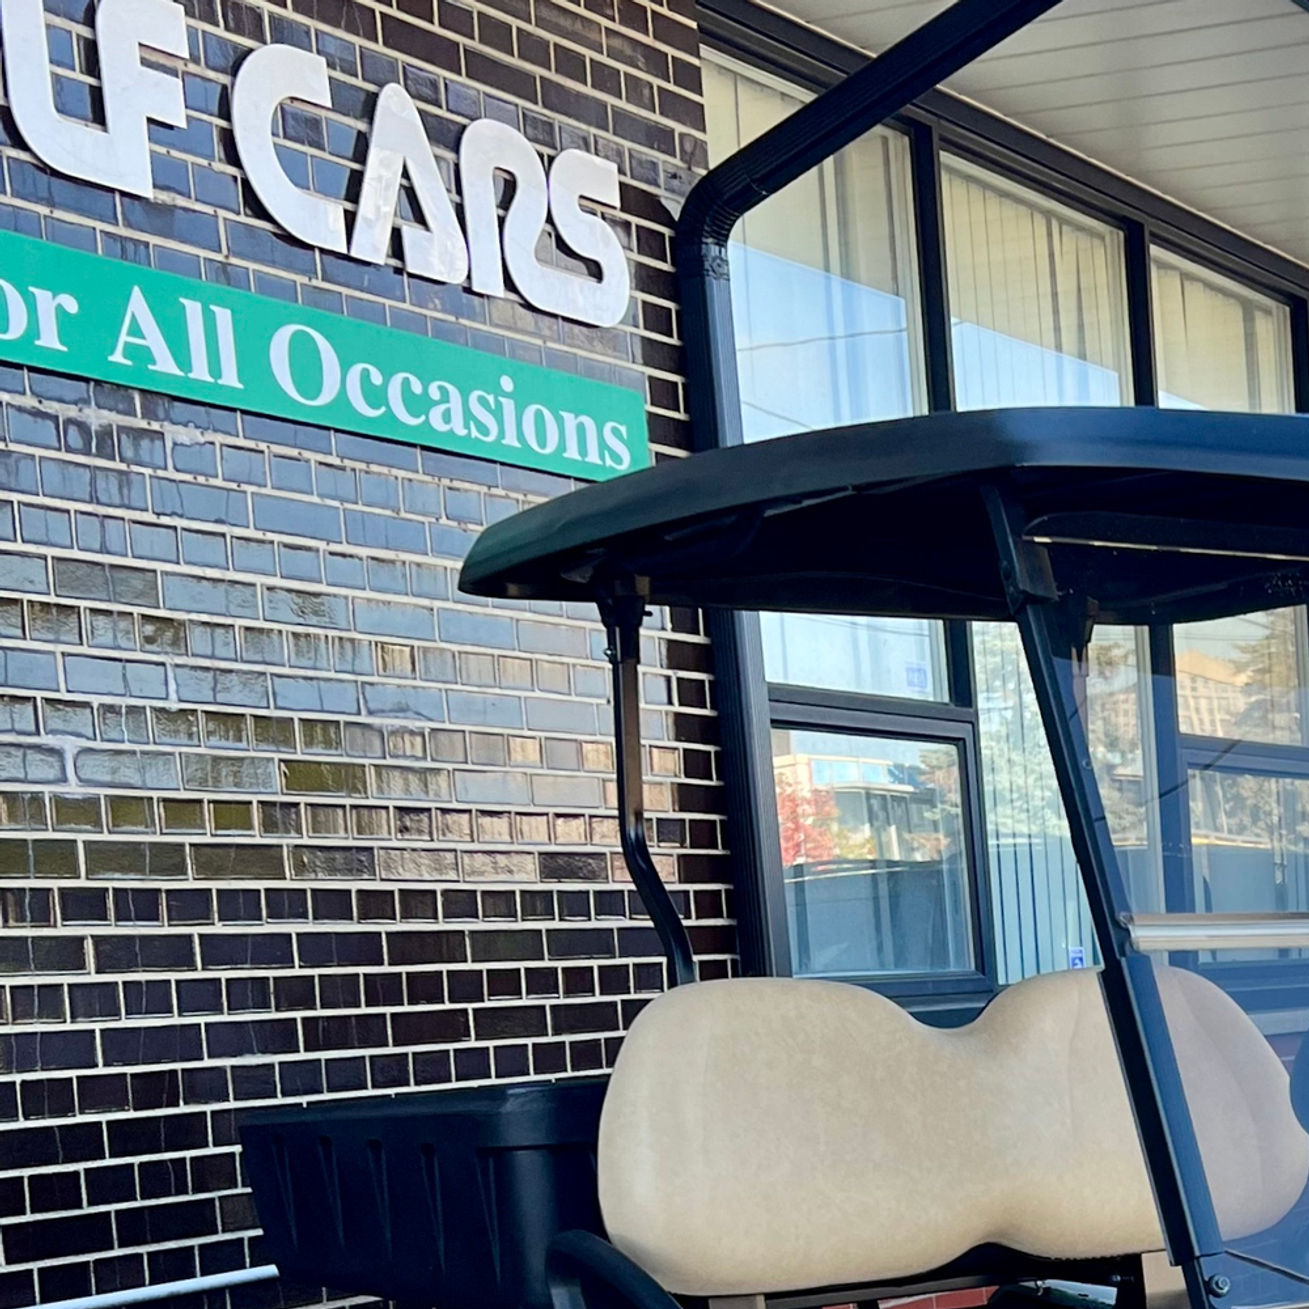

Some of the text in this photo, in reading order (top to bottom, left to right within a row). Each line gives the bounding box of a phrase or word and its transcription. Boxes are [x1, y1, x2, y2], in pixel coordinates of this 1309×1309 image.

[230, 43, 631, 328] CARS
[107, 284, 244, 390] All
[268, 322, 632, 471] Occasions
